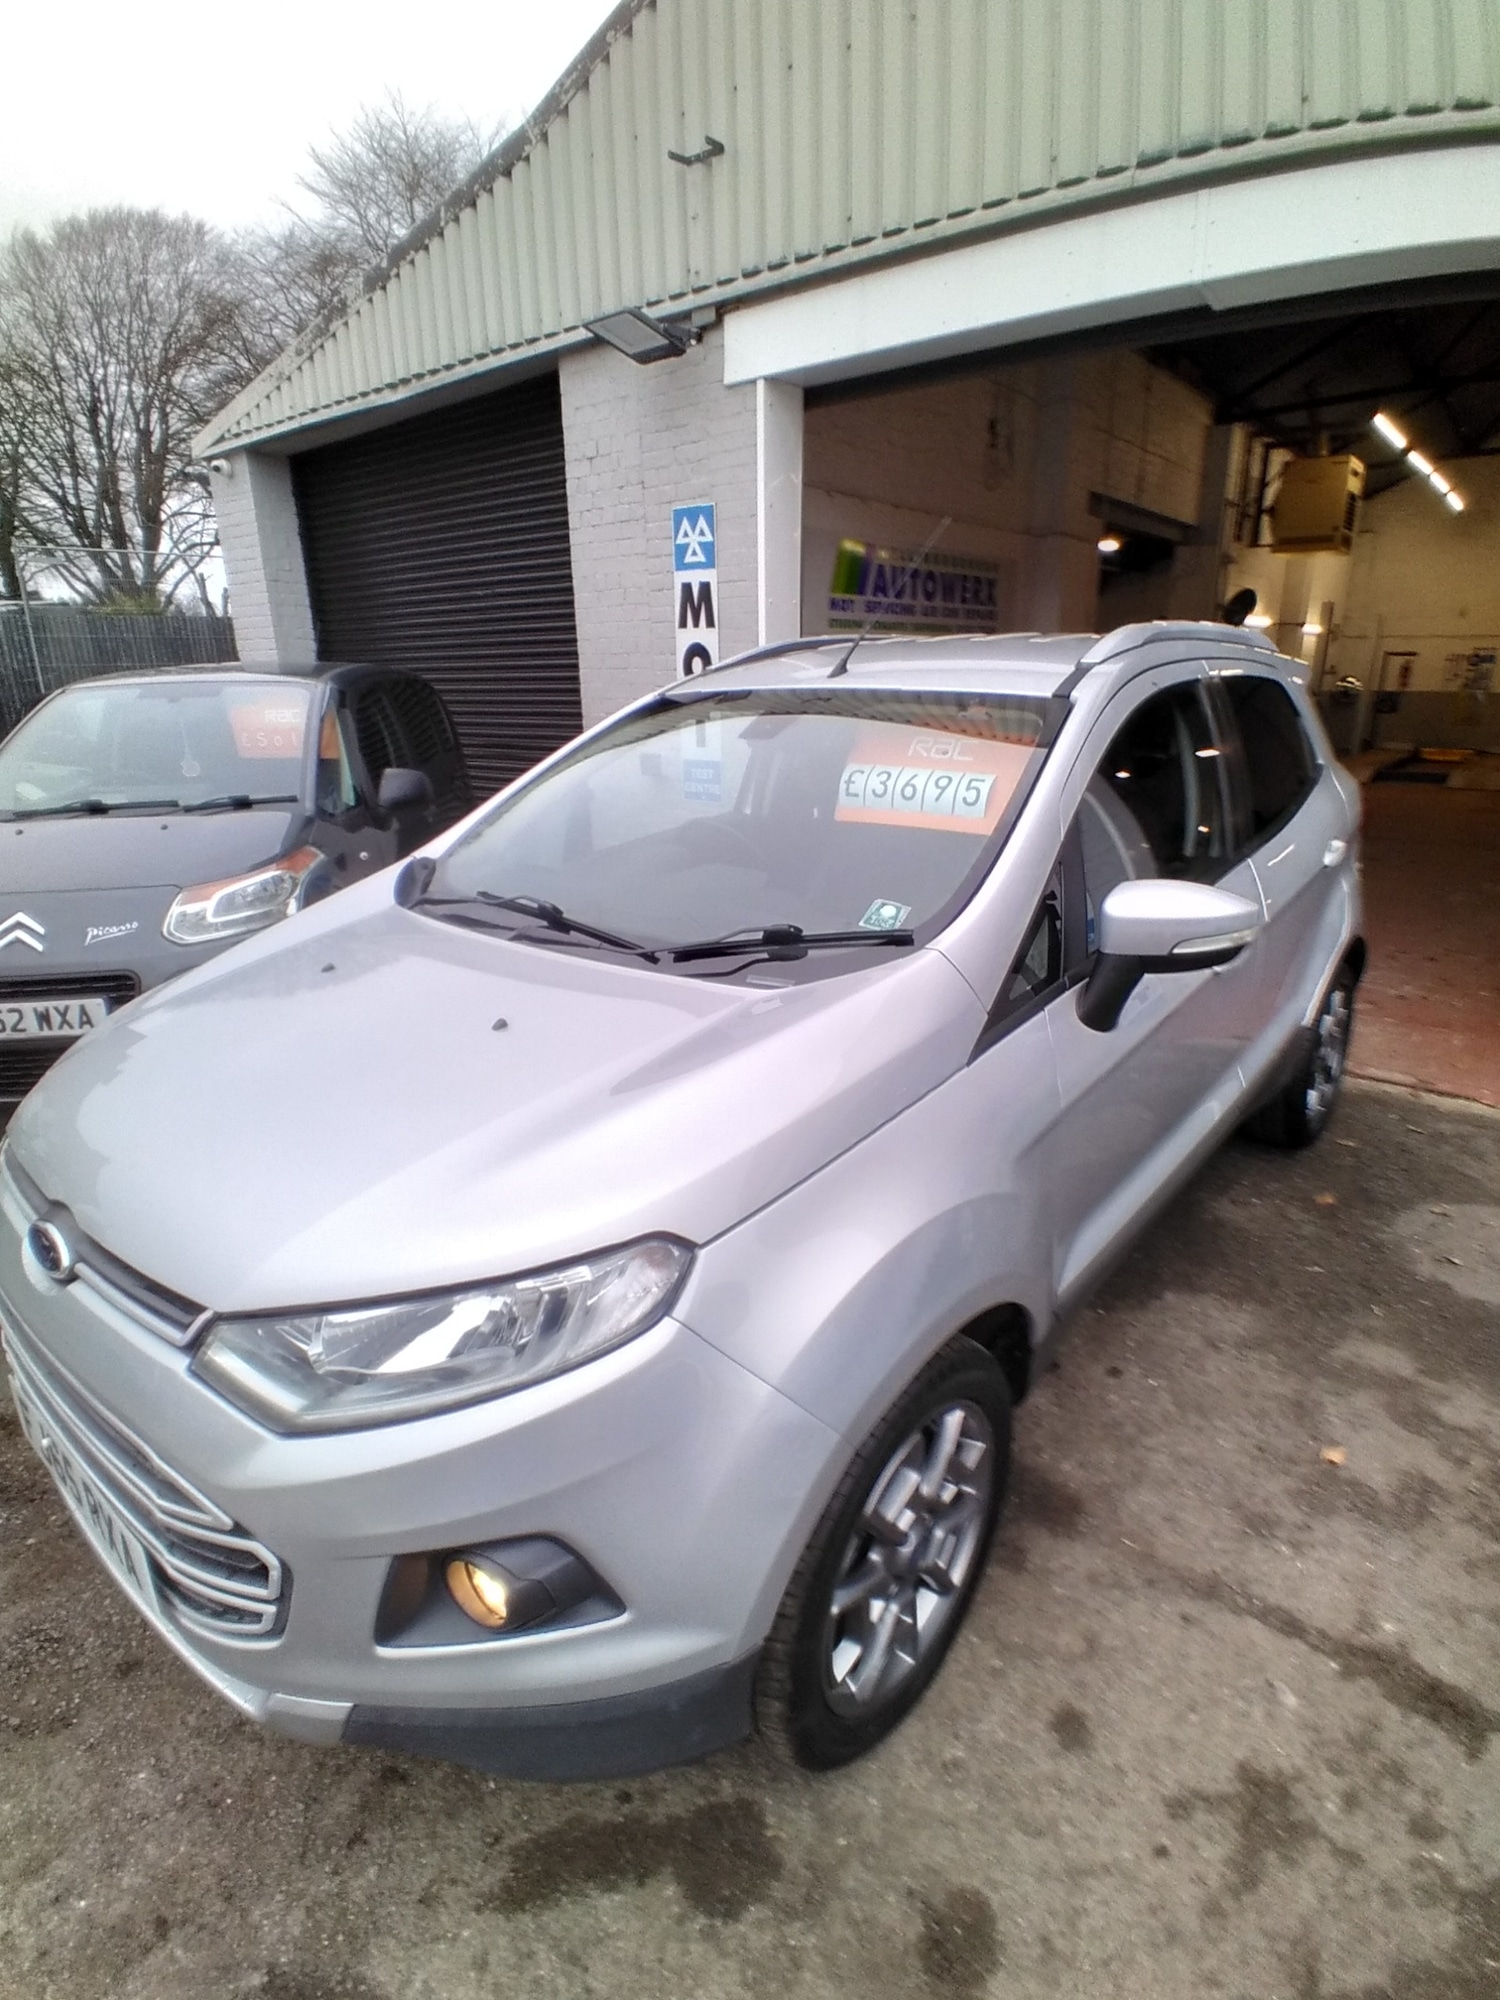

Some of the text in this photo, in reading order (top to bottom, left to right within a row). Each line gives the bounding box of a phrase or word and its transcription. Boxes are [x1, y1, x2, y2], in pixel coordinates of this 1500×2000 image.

[690, 767, 714, 779] TEST
[843, 769, 985, 807] £3695
[84, 921, 139, 946] Picasso
[33, 1004, 94, 1032] WXA
[81, 1477, 143, 1591] RXA
